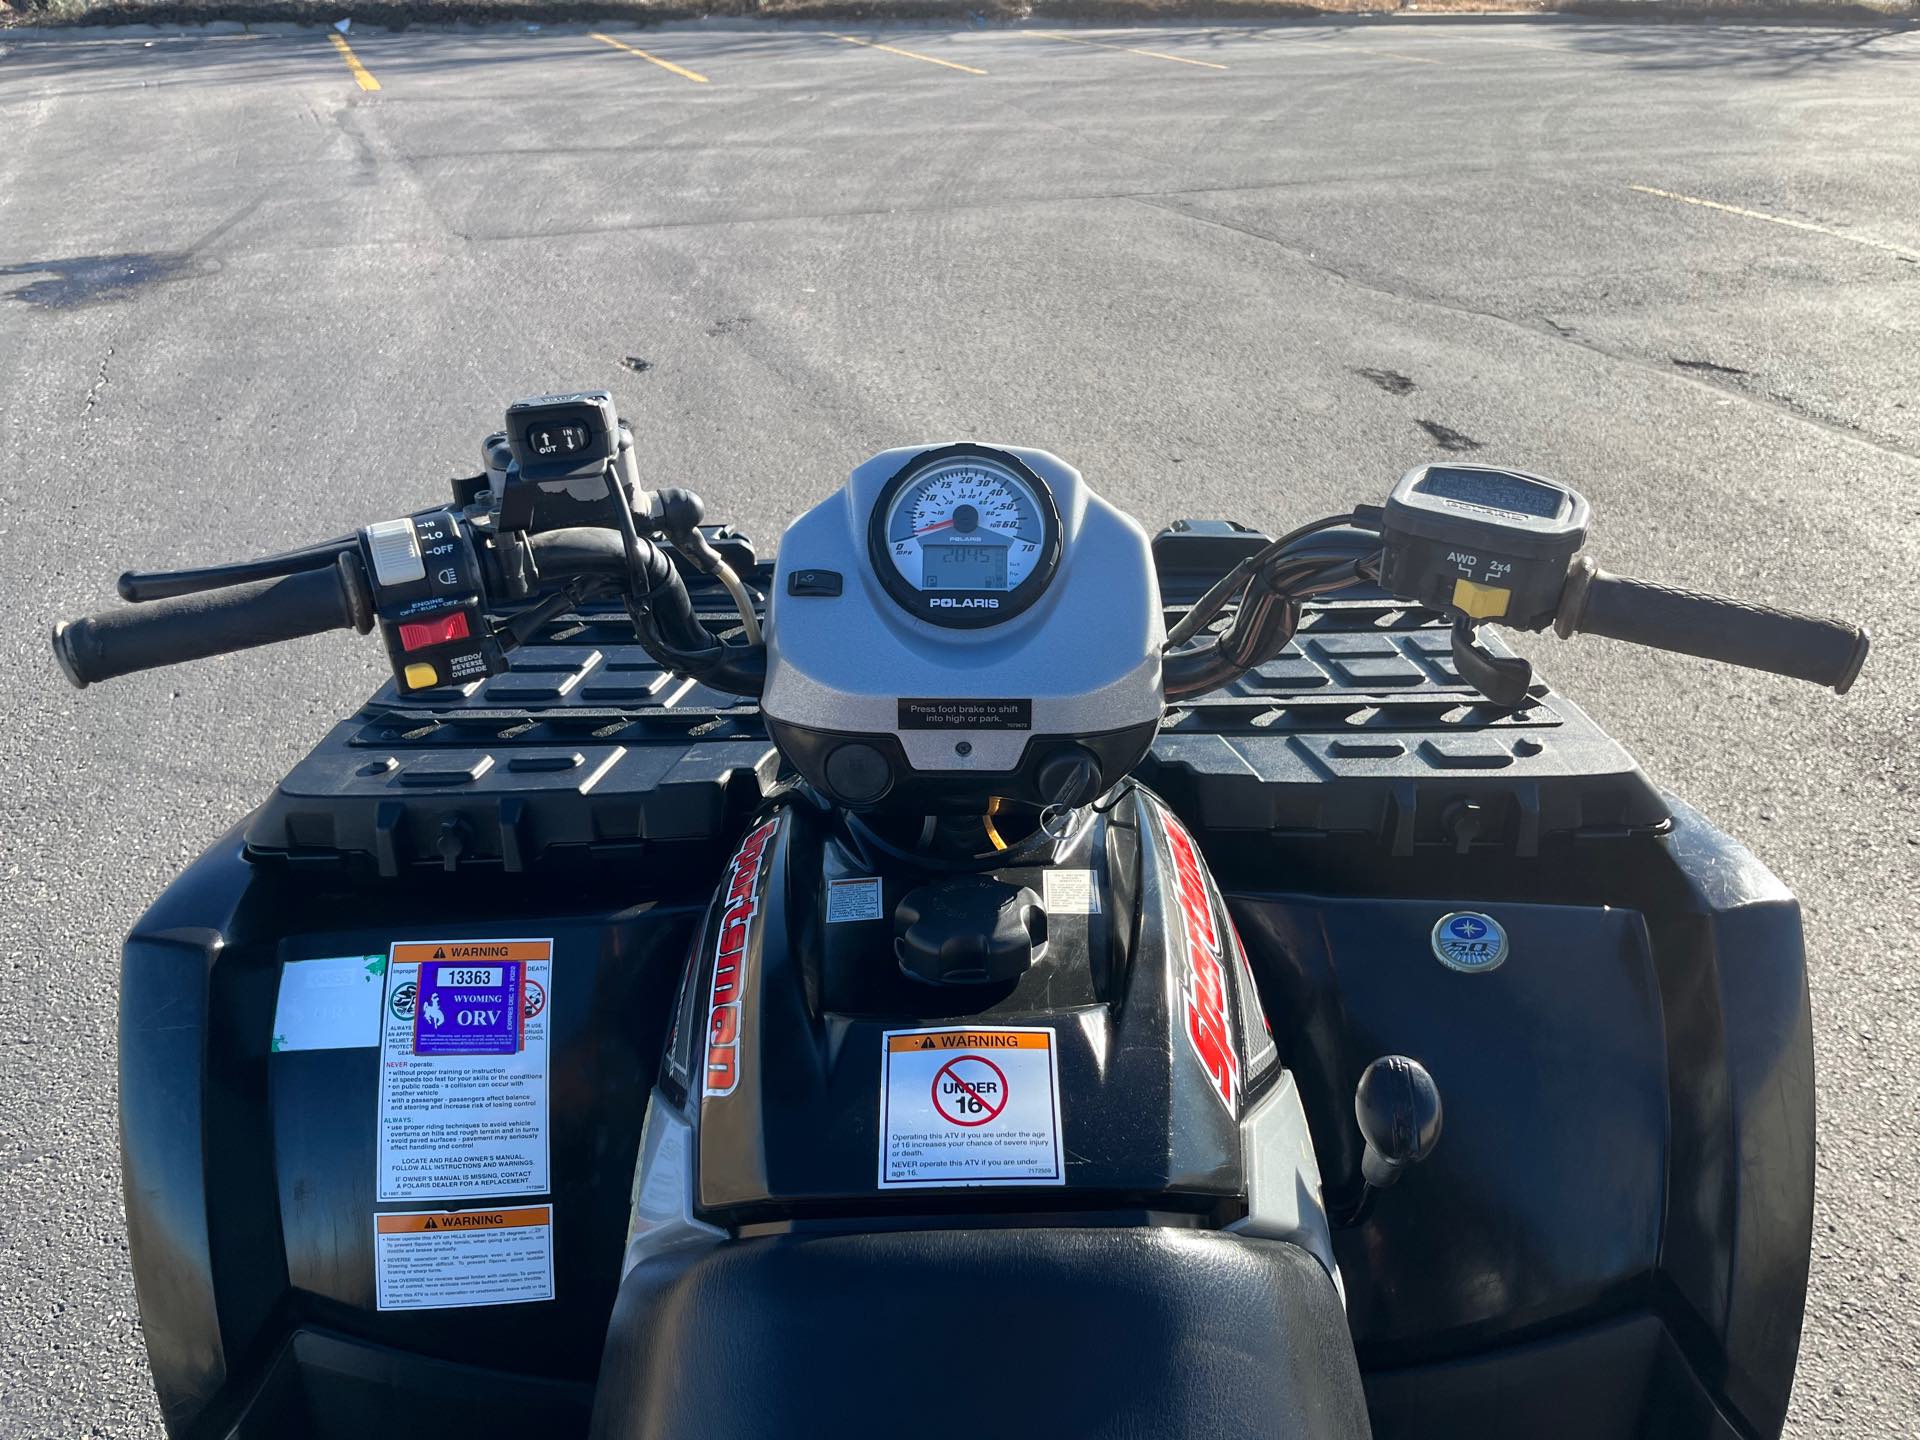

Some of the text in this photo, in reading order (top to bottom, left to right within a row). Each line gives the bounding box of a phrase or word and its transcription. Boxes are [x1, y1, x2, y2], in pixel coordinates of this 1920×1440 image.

[540, 445, 557, 454] OUT
[428, 531, 443, 540] LO
[433, 544, 454, 555] OFF
[1447, 552, 1477, 565] AWD
[1490, 561, 1512, 573] 2x4
[412, 598, 444, 608] ENGINE
[930, 599, 999, 608] POLARIS
[451, 652, 482, 665] SPEEDO/
[452, 659, 484, 670] REVERSE
[452, 665, 488, 678] OVERRIDE
[946, 715, 965, 723] high
[980, 715, 1002, 723] park.
[451, 946, 509, 957] WARNING
[1451, 942, 1488, 951] 50
[703, 818, 780, 1096] Sportsman
[448, 970, 491, 984] 13363
[457, 1010, 501, 1026] ORV
[941, 1035, 1018, 1047] WARNING
[944, 1082, 997, 1094] UNDER
[956, 1097, 983, 1113] 16
[892, 1133, 928, 1141] Operating
[1030, 1139, 1048, 1148] injury
[920, 1160, 947, 1169] operate
[442, 1214, 503, 1226] WARNING
